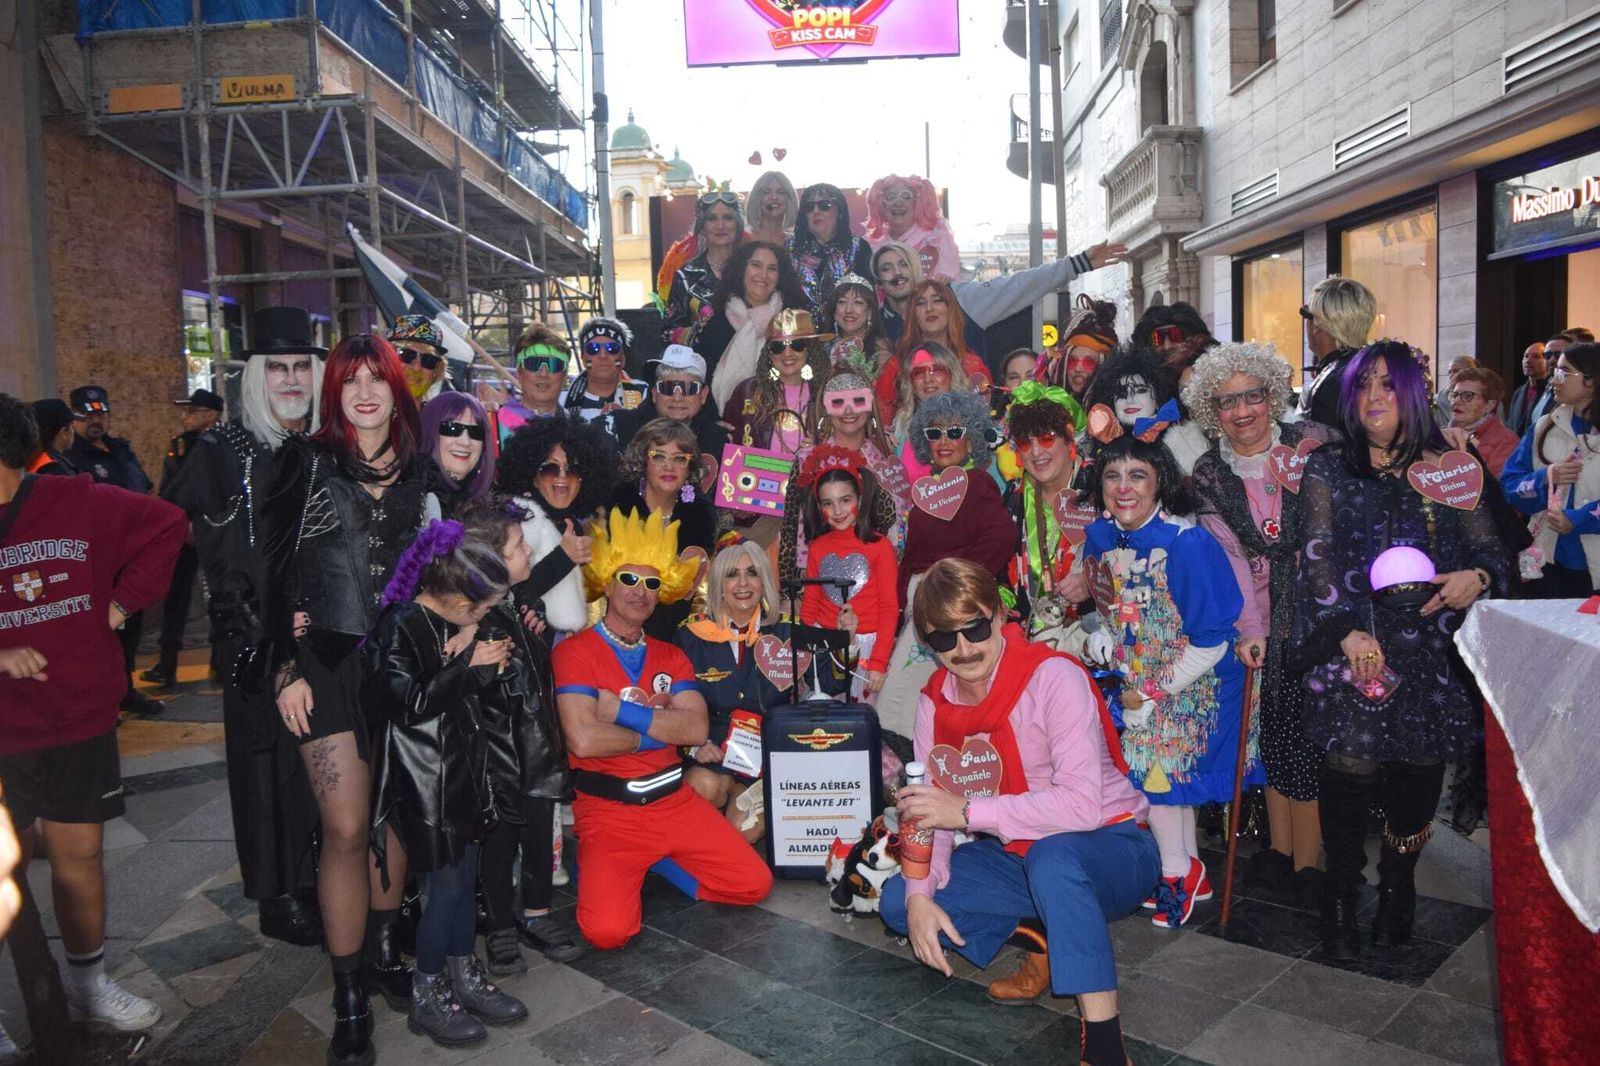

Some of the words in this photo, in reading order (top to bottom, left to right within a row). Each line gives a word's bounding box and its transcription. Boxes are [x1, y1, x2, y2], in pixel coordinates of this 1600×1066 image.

[792, 7, 851, 29] POPI
[791, 29, 822, 42] KISS
[824, 27, 856, 41] CAM
[245, 83, 284, 97] ULMA
[1511, 187, 1575, 224] Massimo
[927, 475, 965, 496] Antonia
[939, 494, 961, 505] Viciosa
[768, 669, 794, 679] Madur
[960, 751, 997, 768] Paolo
[780, 780, 817, 791] LÍNEAS
[820, 780, 861, 790] AÉREAS
[806, 826, 838, 836] HADÚ
